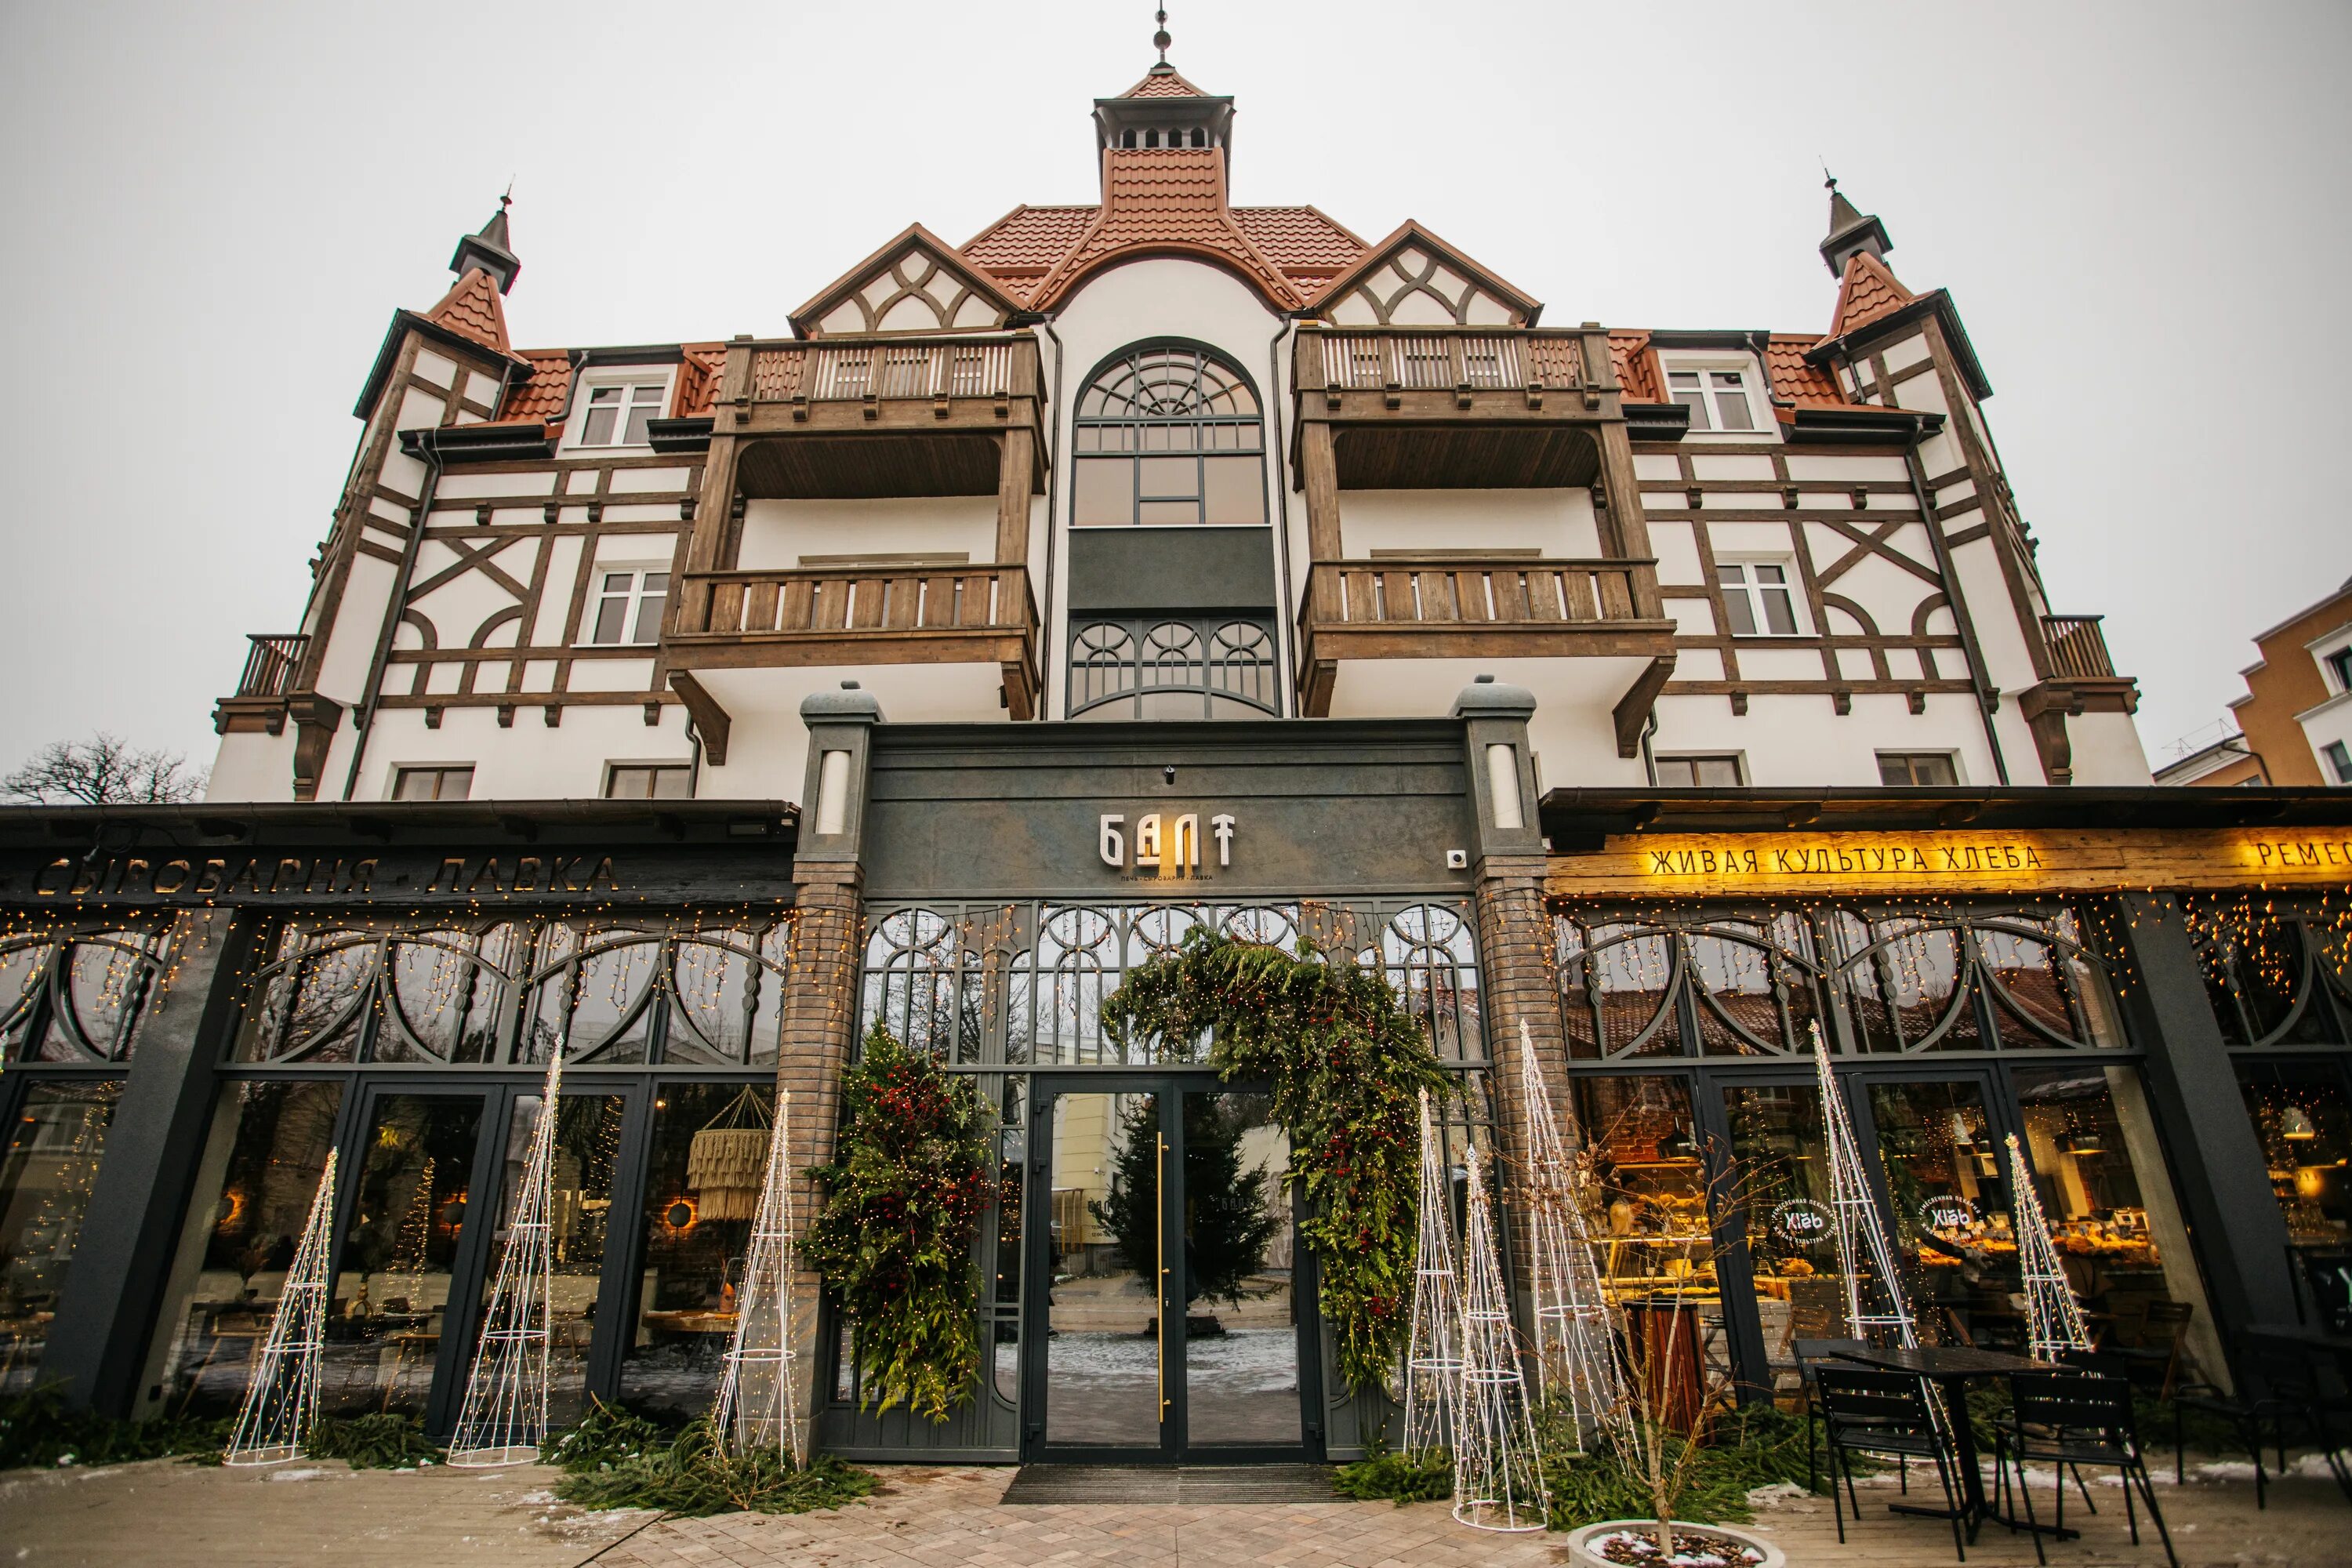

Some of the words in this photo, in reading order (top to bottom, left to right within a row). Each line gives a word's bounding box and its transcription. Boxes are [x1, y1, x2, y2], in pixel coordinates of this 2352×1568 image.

[1100, 814, 1235, 867] БАЛТ
[1650, 849, 1759, 873] ЖИВАЯ
[1775, 848, 1928, 872] КУЛЬТУРА
[1942, 846, 2042, 869] ХЛЕБА
[34, 858, 379, 895] СЫРОВАРНЯ
[425, 857, 619, 893] ЛАВКА
[1772, 1199, 1807, 1219] РЕМЕСЛЕННАЯ
[1809, 1200, 1834, 1217] ПЕКАРНЯ
[1918, 1195, 1952, 1216] РЕМЕСЛЕННАЯ
[1955, 1196, 1981, 1214] ПЕКАРНЯ
[1773, 1225, 1792, 1241] ЖИВАЯ
